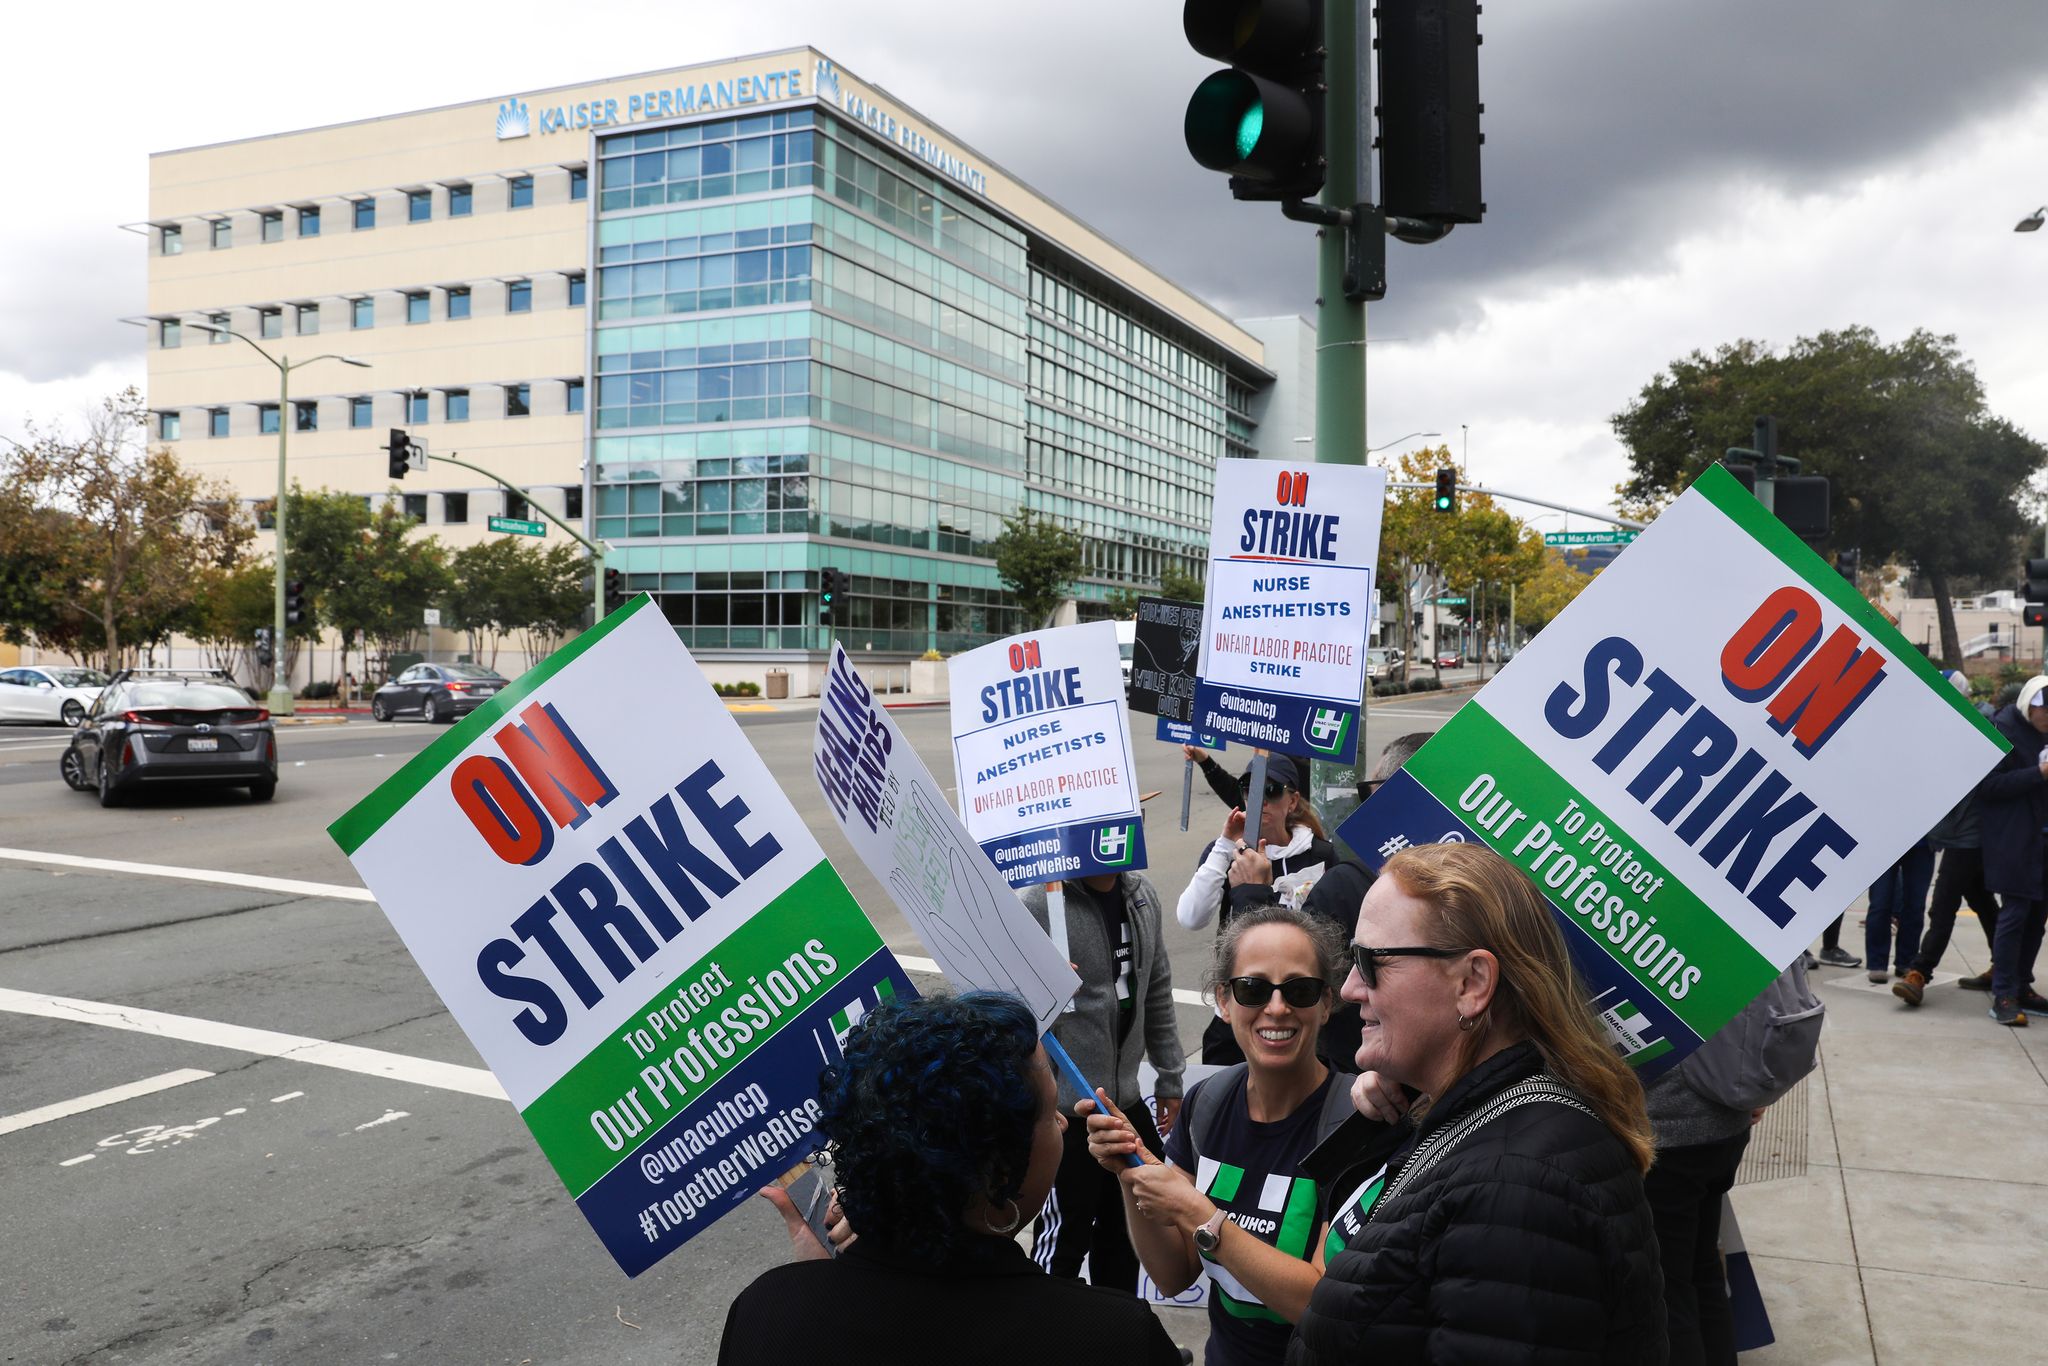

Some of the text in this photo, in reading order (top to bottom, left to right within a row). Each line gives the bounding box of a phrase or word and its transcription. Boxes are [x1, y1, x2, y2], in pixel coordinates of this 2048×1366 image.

[539, 68, 801, 136] KAISER PERMANENTE
[843, 91, 987, 197] KAISER PERMANENTE
[1277, 470, 1309, 507] ON
[1240, 509, 1339, 561] STRIKE
[1558, 535, 1566, 543] W
[1568, 534, 1585, 543] Mac
[1586, 533, 1614, 543] Arthur
[1253, 576, 1310, 592] NURSE
[1222, 601, 1351, 620] ANESTHETISTS
[1009, 640, 1042, 672] ON
[1216, 632, 1353, 666] UNFAIR LABOR PRACTICE
[1250, 662, 1301, 678] STRIKE
[1720, 586, 1887, 761] ON
[981, 667, 1084, 723] STRIKE
[1135, 668, 1195, 700] WHILE KAIS
[1219, 691, 1277, 720] @unacuhcp
[814, 648, 870, 824] HEALING
[1003, 720, 1062, 750] NURSE
[1205, 711, 1290, 744] #TogetherWeRise
[851, 709, 892, 835] HANDS
[976, 732, 1106, 785] ANESTHETISTS
[1544, 636, 1858, 929] STRIKE
[451, 701, 620, 866] ON
[974, 767, 1119, 814] UNFAIR LABOR PRACTICE
[1018, 797, 1072, 818] STRIKE
[995, 837, 1061, 864] @unacuhcp
[1002, 855, 1081, 882] getherWeRise
[1555, 798, 1664, 903] To Protect
[477, 759, 783, 1046] STRIKE
[1458, 773, 1702, 1000] Our Professions
[623, 961, 734, 1060] To Protect
[1604, 1012, 1642, 1049] UNAC/UHCP
[590, 938, 838, 1152] Our Professions
[640, 1082, 769, 1184] @unacuhcp
[638, 1098, 823, 1243] #TogetherWeRise
[1224, 1210, 1277, 1235] C/UHCP
